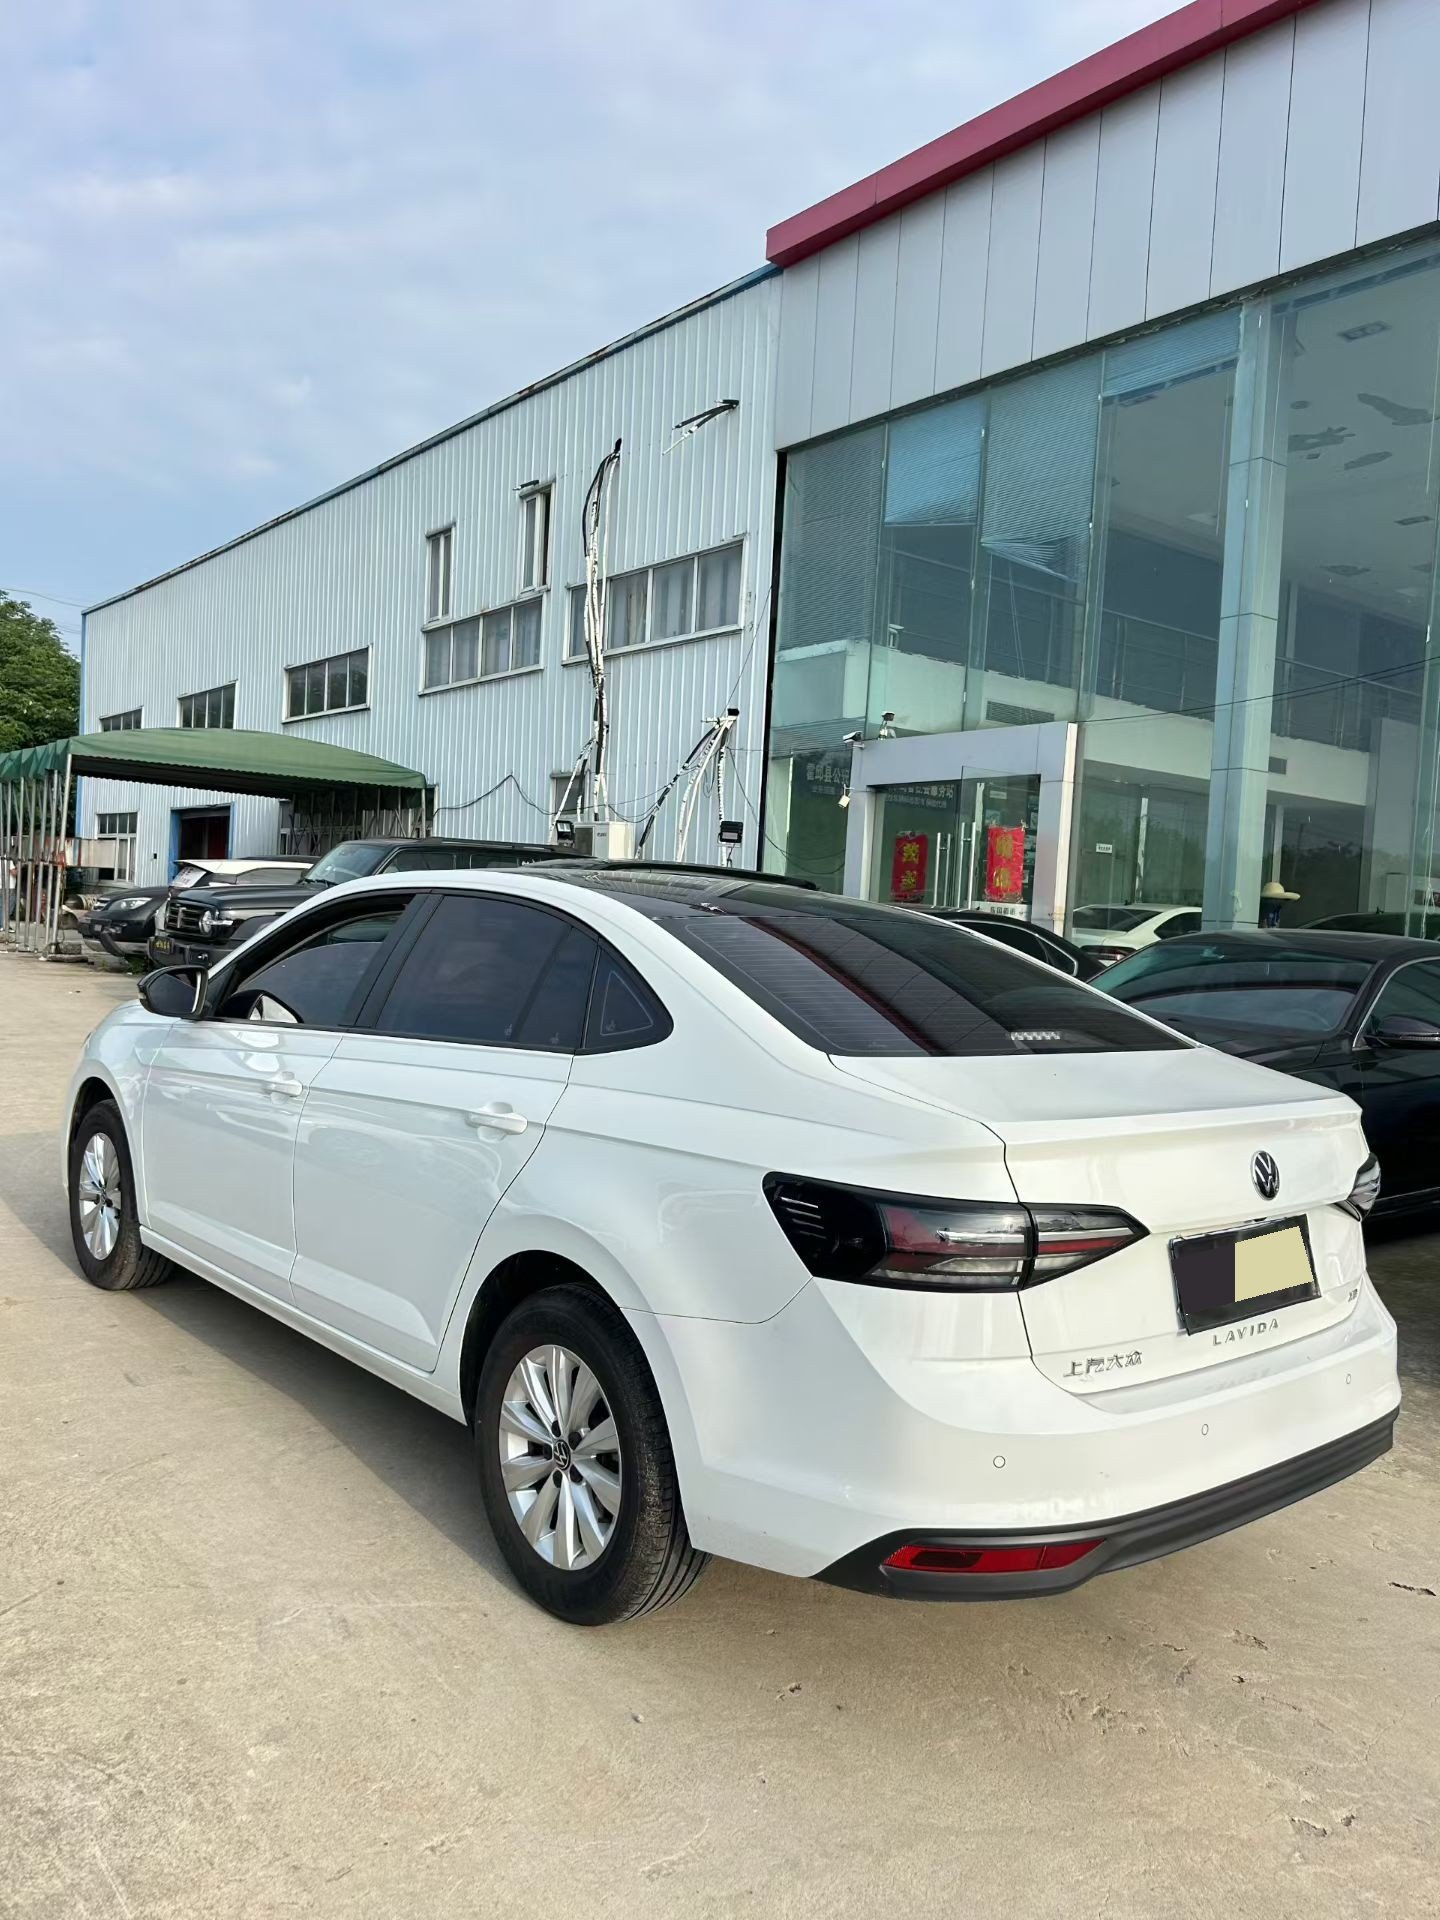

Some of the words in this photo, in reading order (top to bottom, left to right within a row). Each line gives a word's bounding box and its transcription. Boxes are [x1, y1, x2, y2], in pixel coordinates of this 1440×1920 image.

[1213, 1318, 1279, 1346] LAVIDA
[1063, 1351, 1143, 1377] 上汽大众
